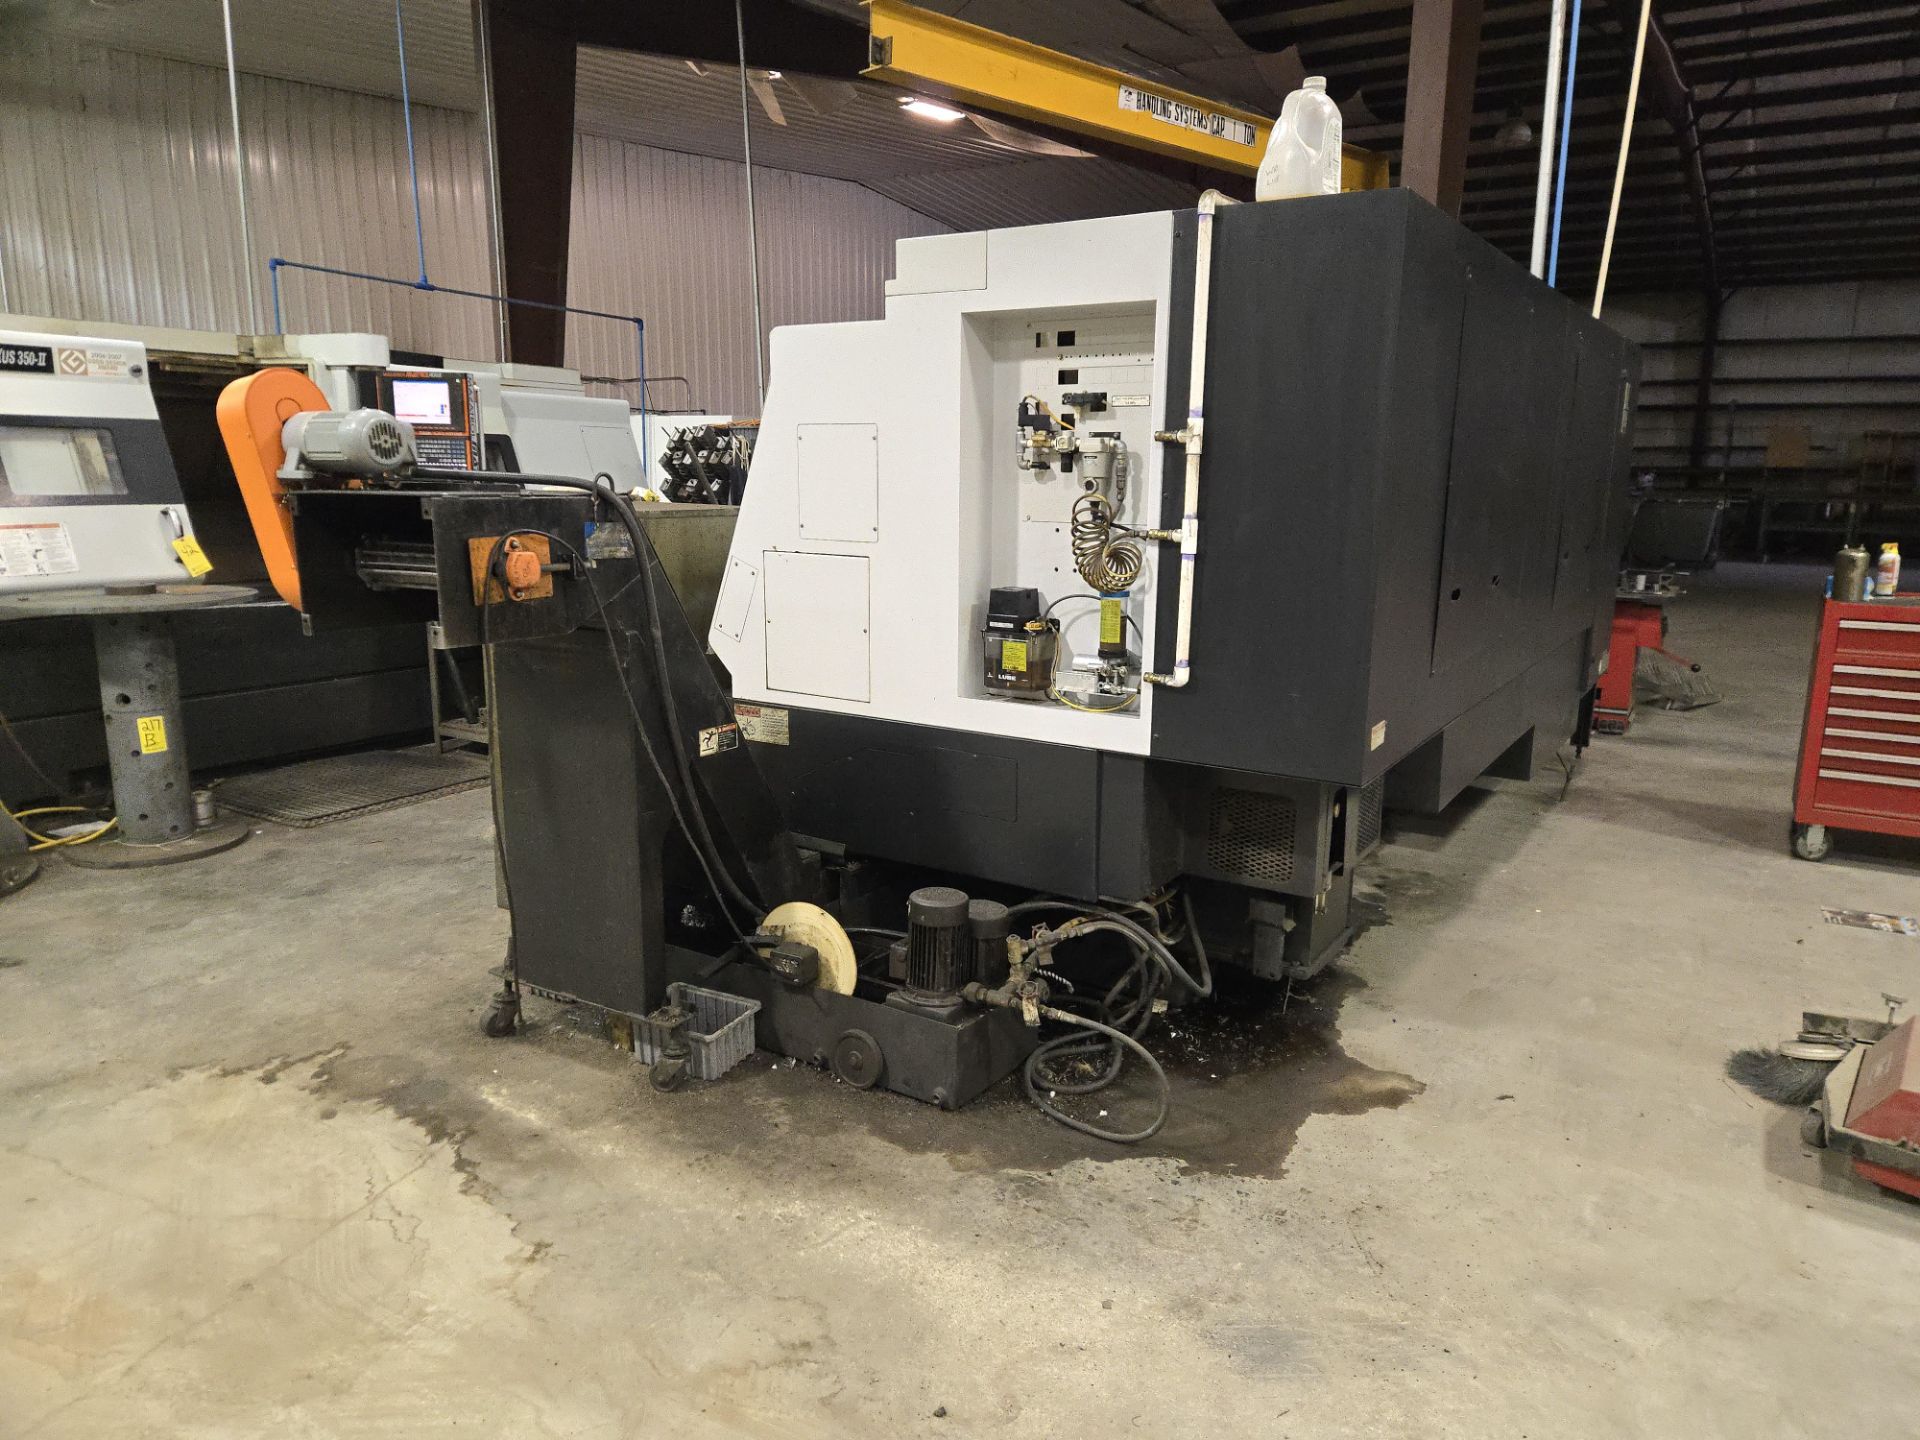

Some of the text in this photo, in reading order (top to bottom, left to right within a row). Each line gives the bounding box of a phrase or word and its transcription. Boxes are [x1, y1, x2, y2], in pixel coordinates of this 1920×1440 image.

[1136, 91, 1172, 119] HANDLING
[1174, 103, 1208, 130] SYSTEMS
[1243, 123, 1257, 146] TON
